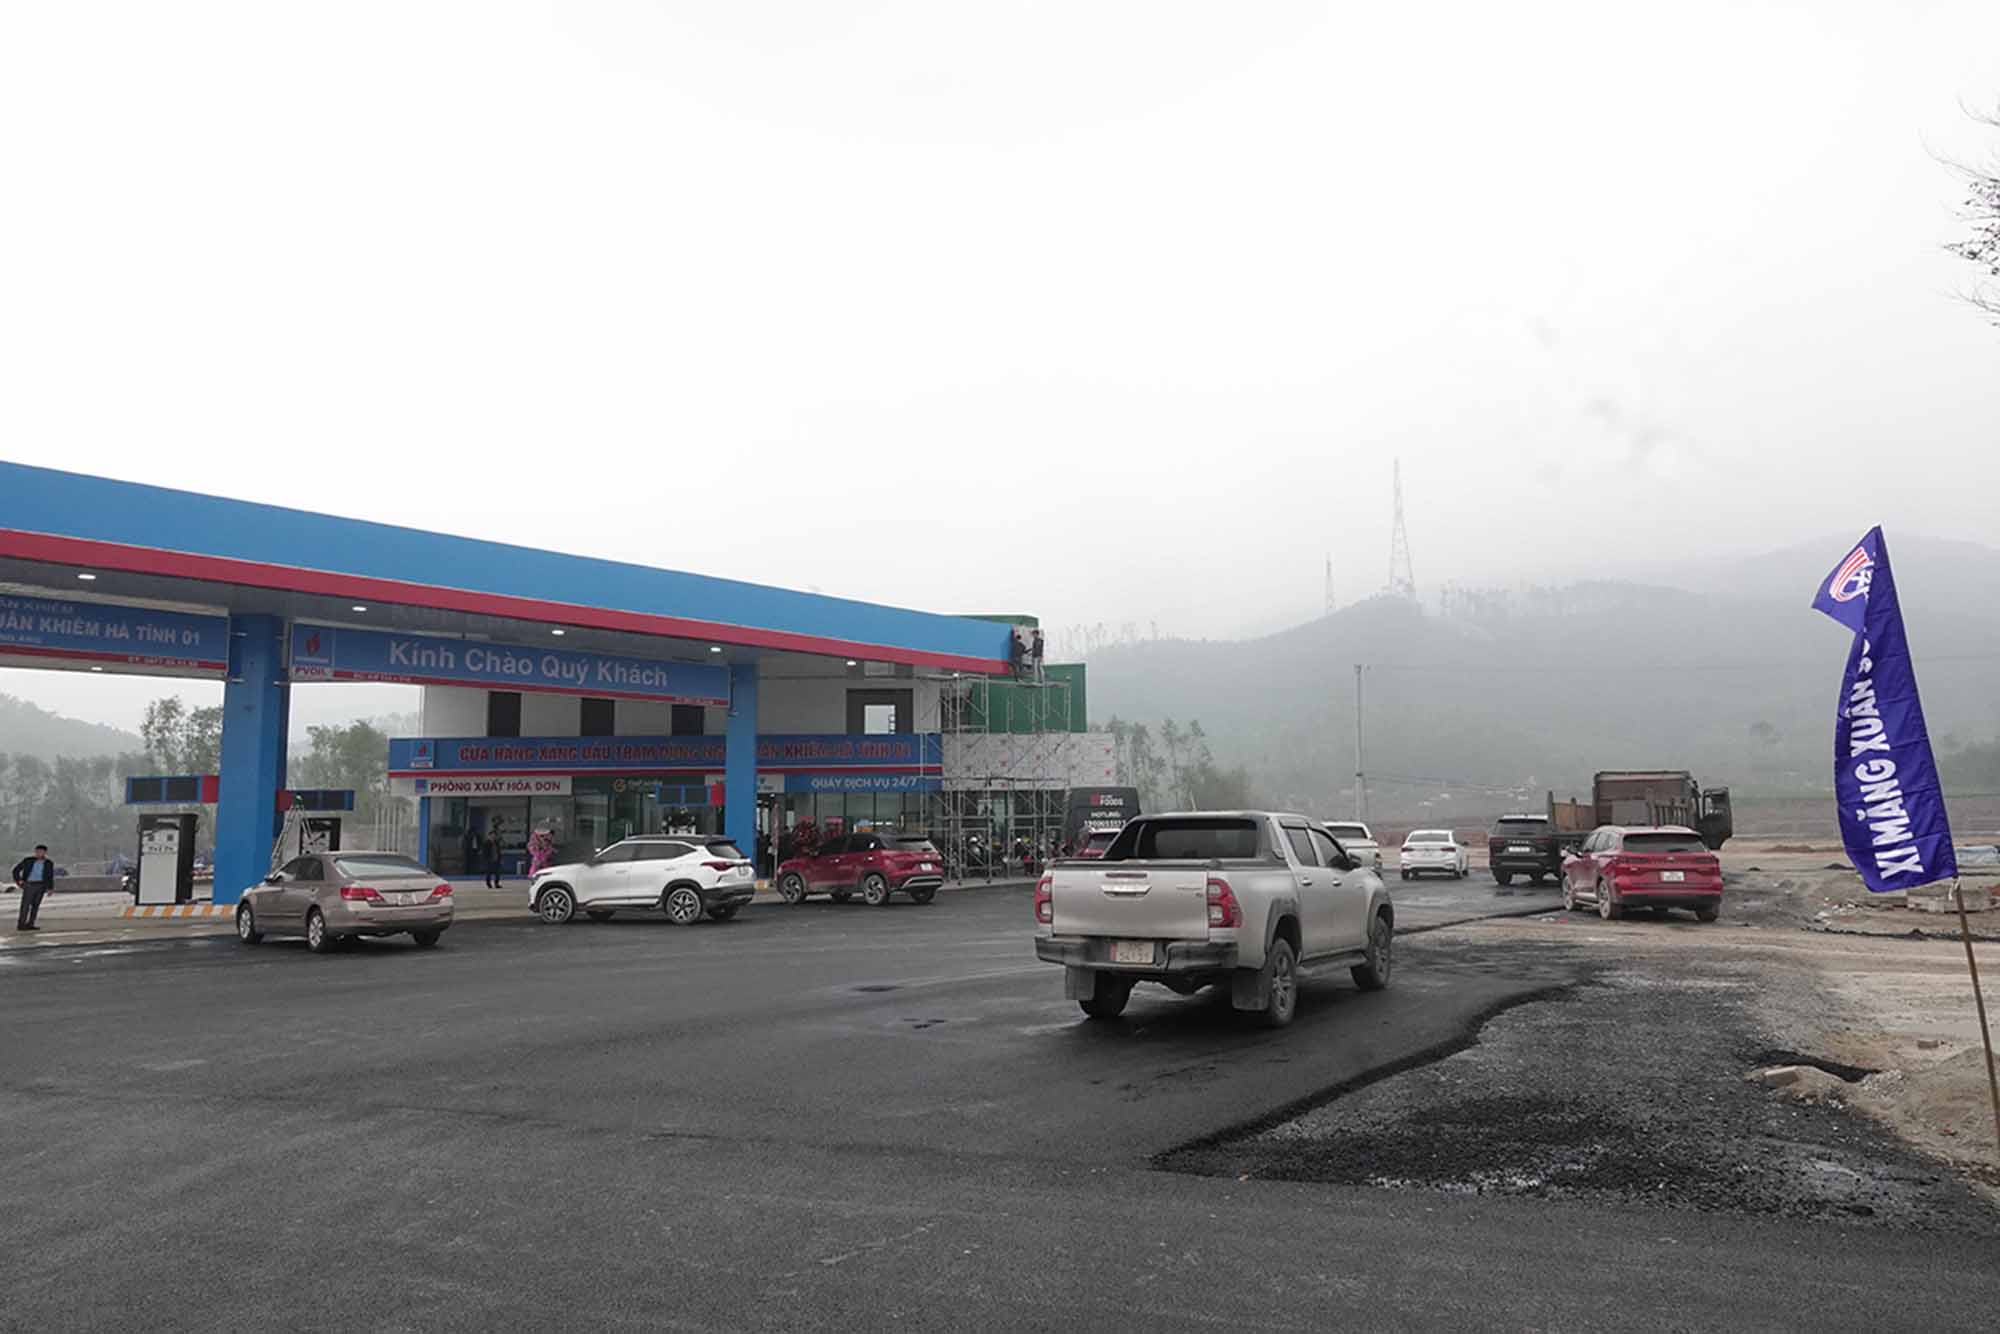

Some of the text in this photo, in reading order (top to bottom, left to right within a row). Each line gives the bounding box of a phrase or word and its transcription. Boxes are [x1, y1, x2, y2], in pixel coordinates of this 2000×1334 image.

[390, 639, 667, 687] Kính Chào Quý Khách
[1845, 678, 1890, 758] XUÂN
[430, 780, 472, 793] PHÒNG
[891, 776, 917, 788] 24/7
[1855, 758, 1915, 847] MĂNG
[1874, 845, 1925, 880] XI
